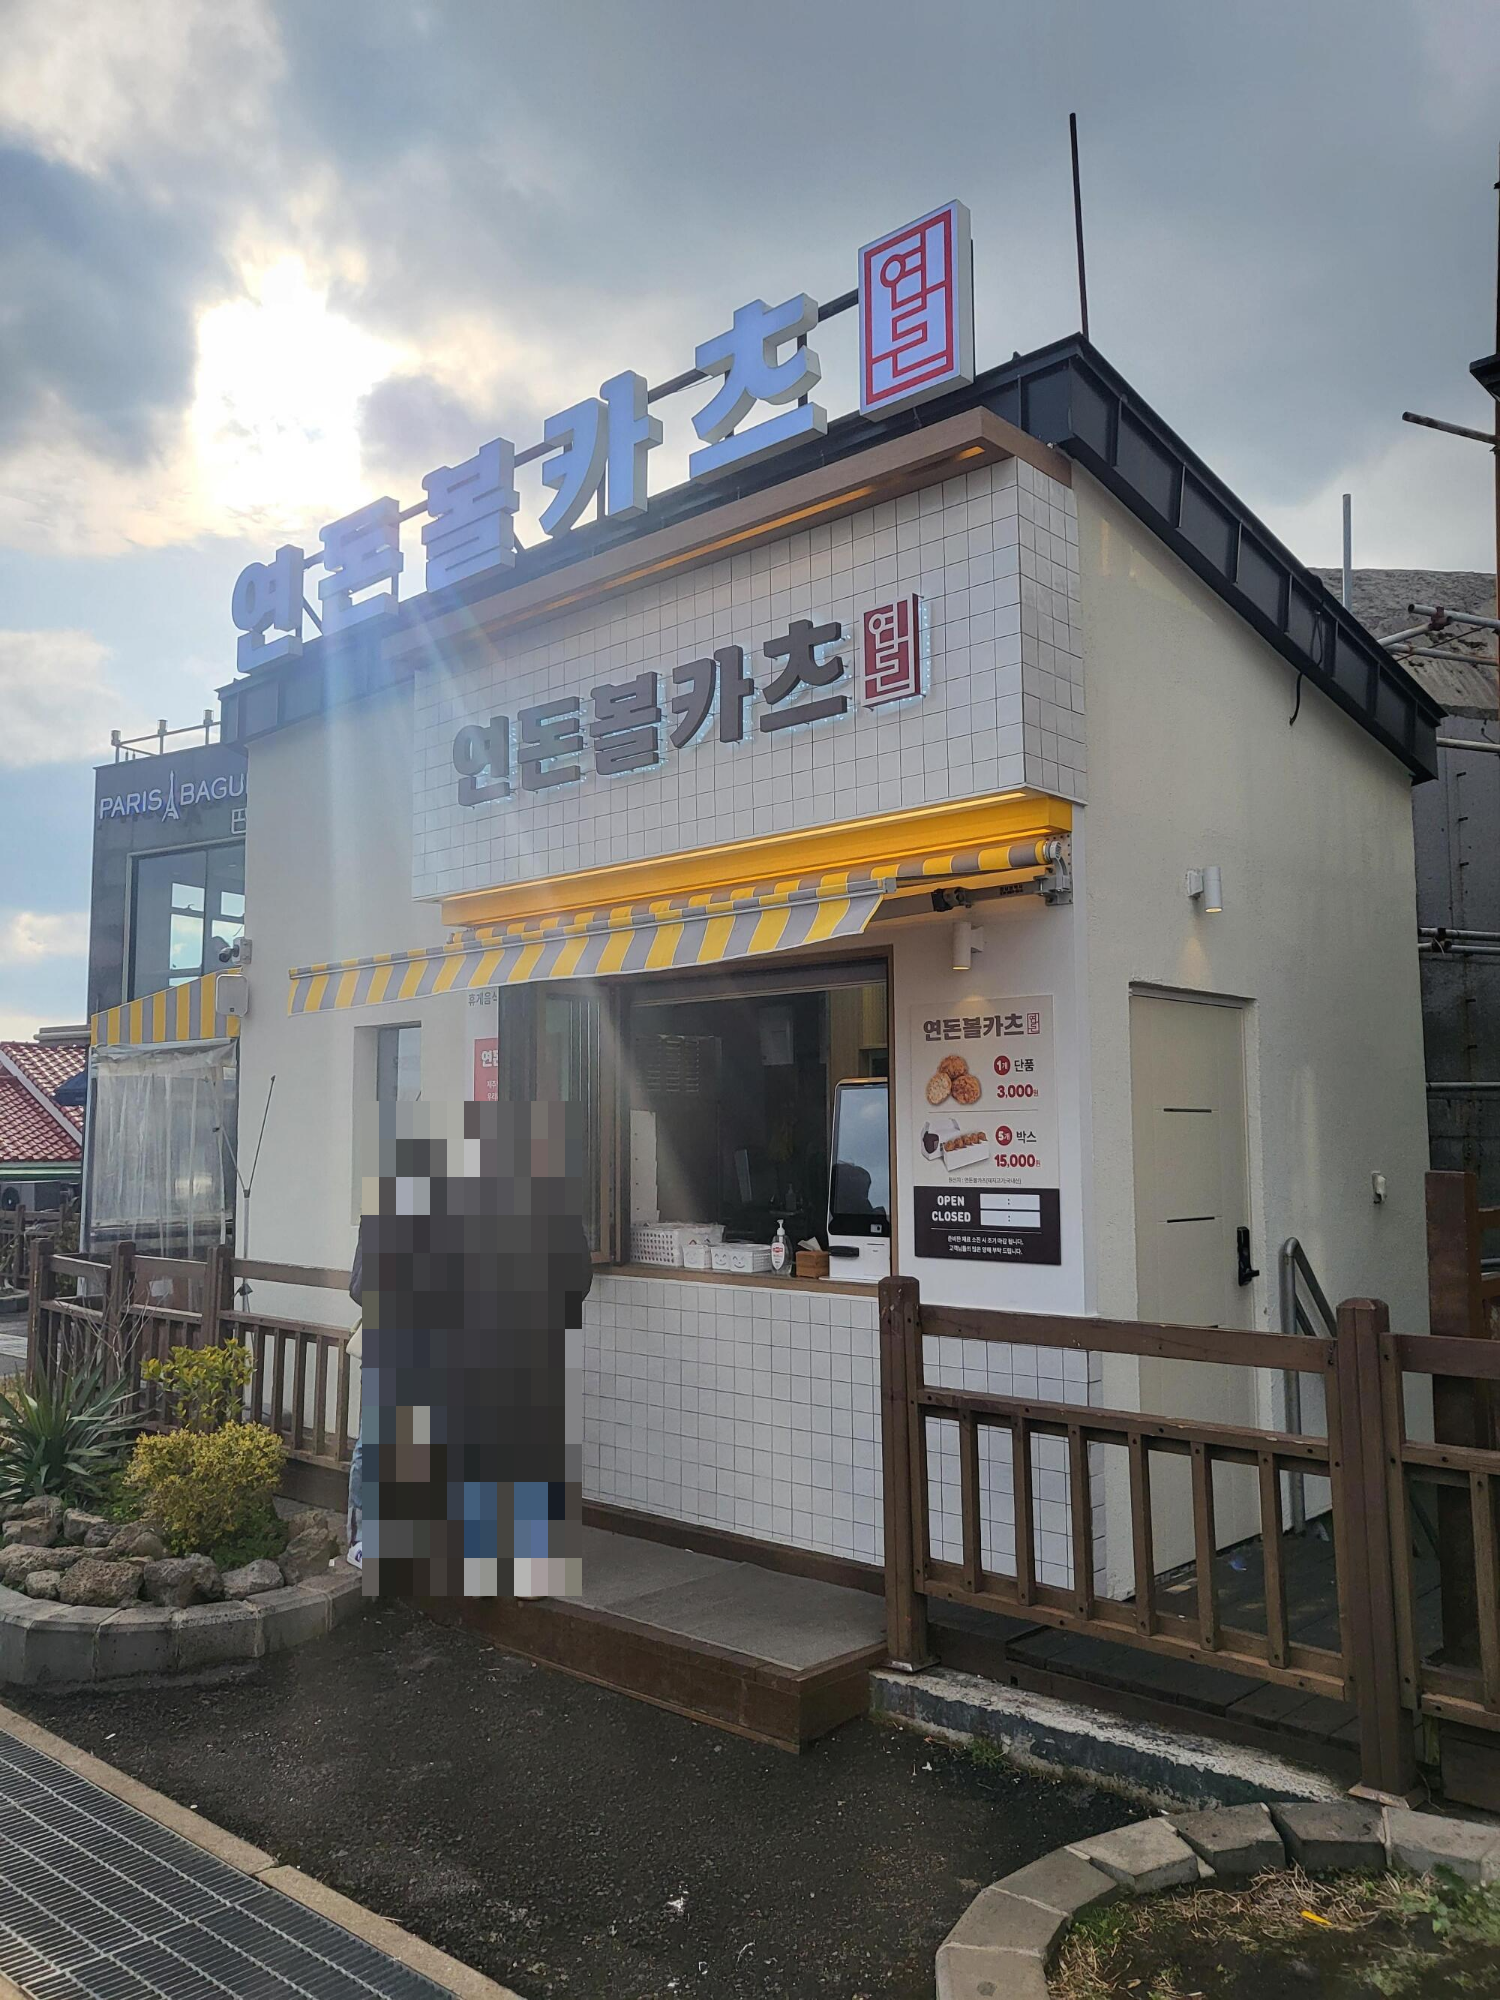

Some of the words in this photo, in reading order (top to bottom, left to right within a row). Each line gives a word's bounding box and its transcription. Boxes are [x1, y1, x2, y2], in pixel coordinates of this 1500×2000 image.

[231, 292, 828, 674] 연돈볼카츠
[453, 619, 848, 807] 연돈볼카츠
[99, 789, 163, 819] PARIS
[180, 773, 247, 806] BAGU
[923, 1013, 1025, 1041] 연돈볼카츠
[1014, 1058, 1035, 1072] 단품
[1016, 1130, 1037, 1144] 박스
[937, 1195, 965, 1206] OPEN
[931, 1211, 971, 1222] CLOSED
